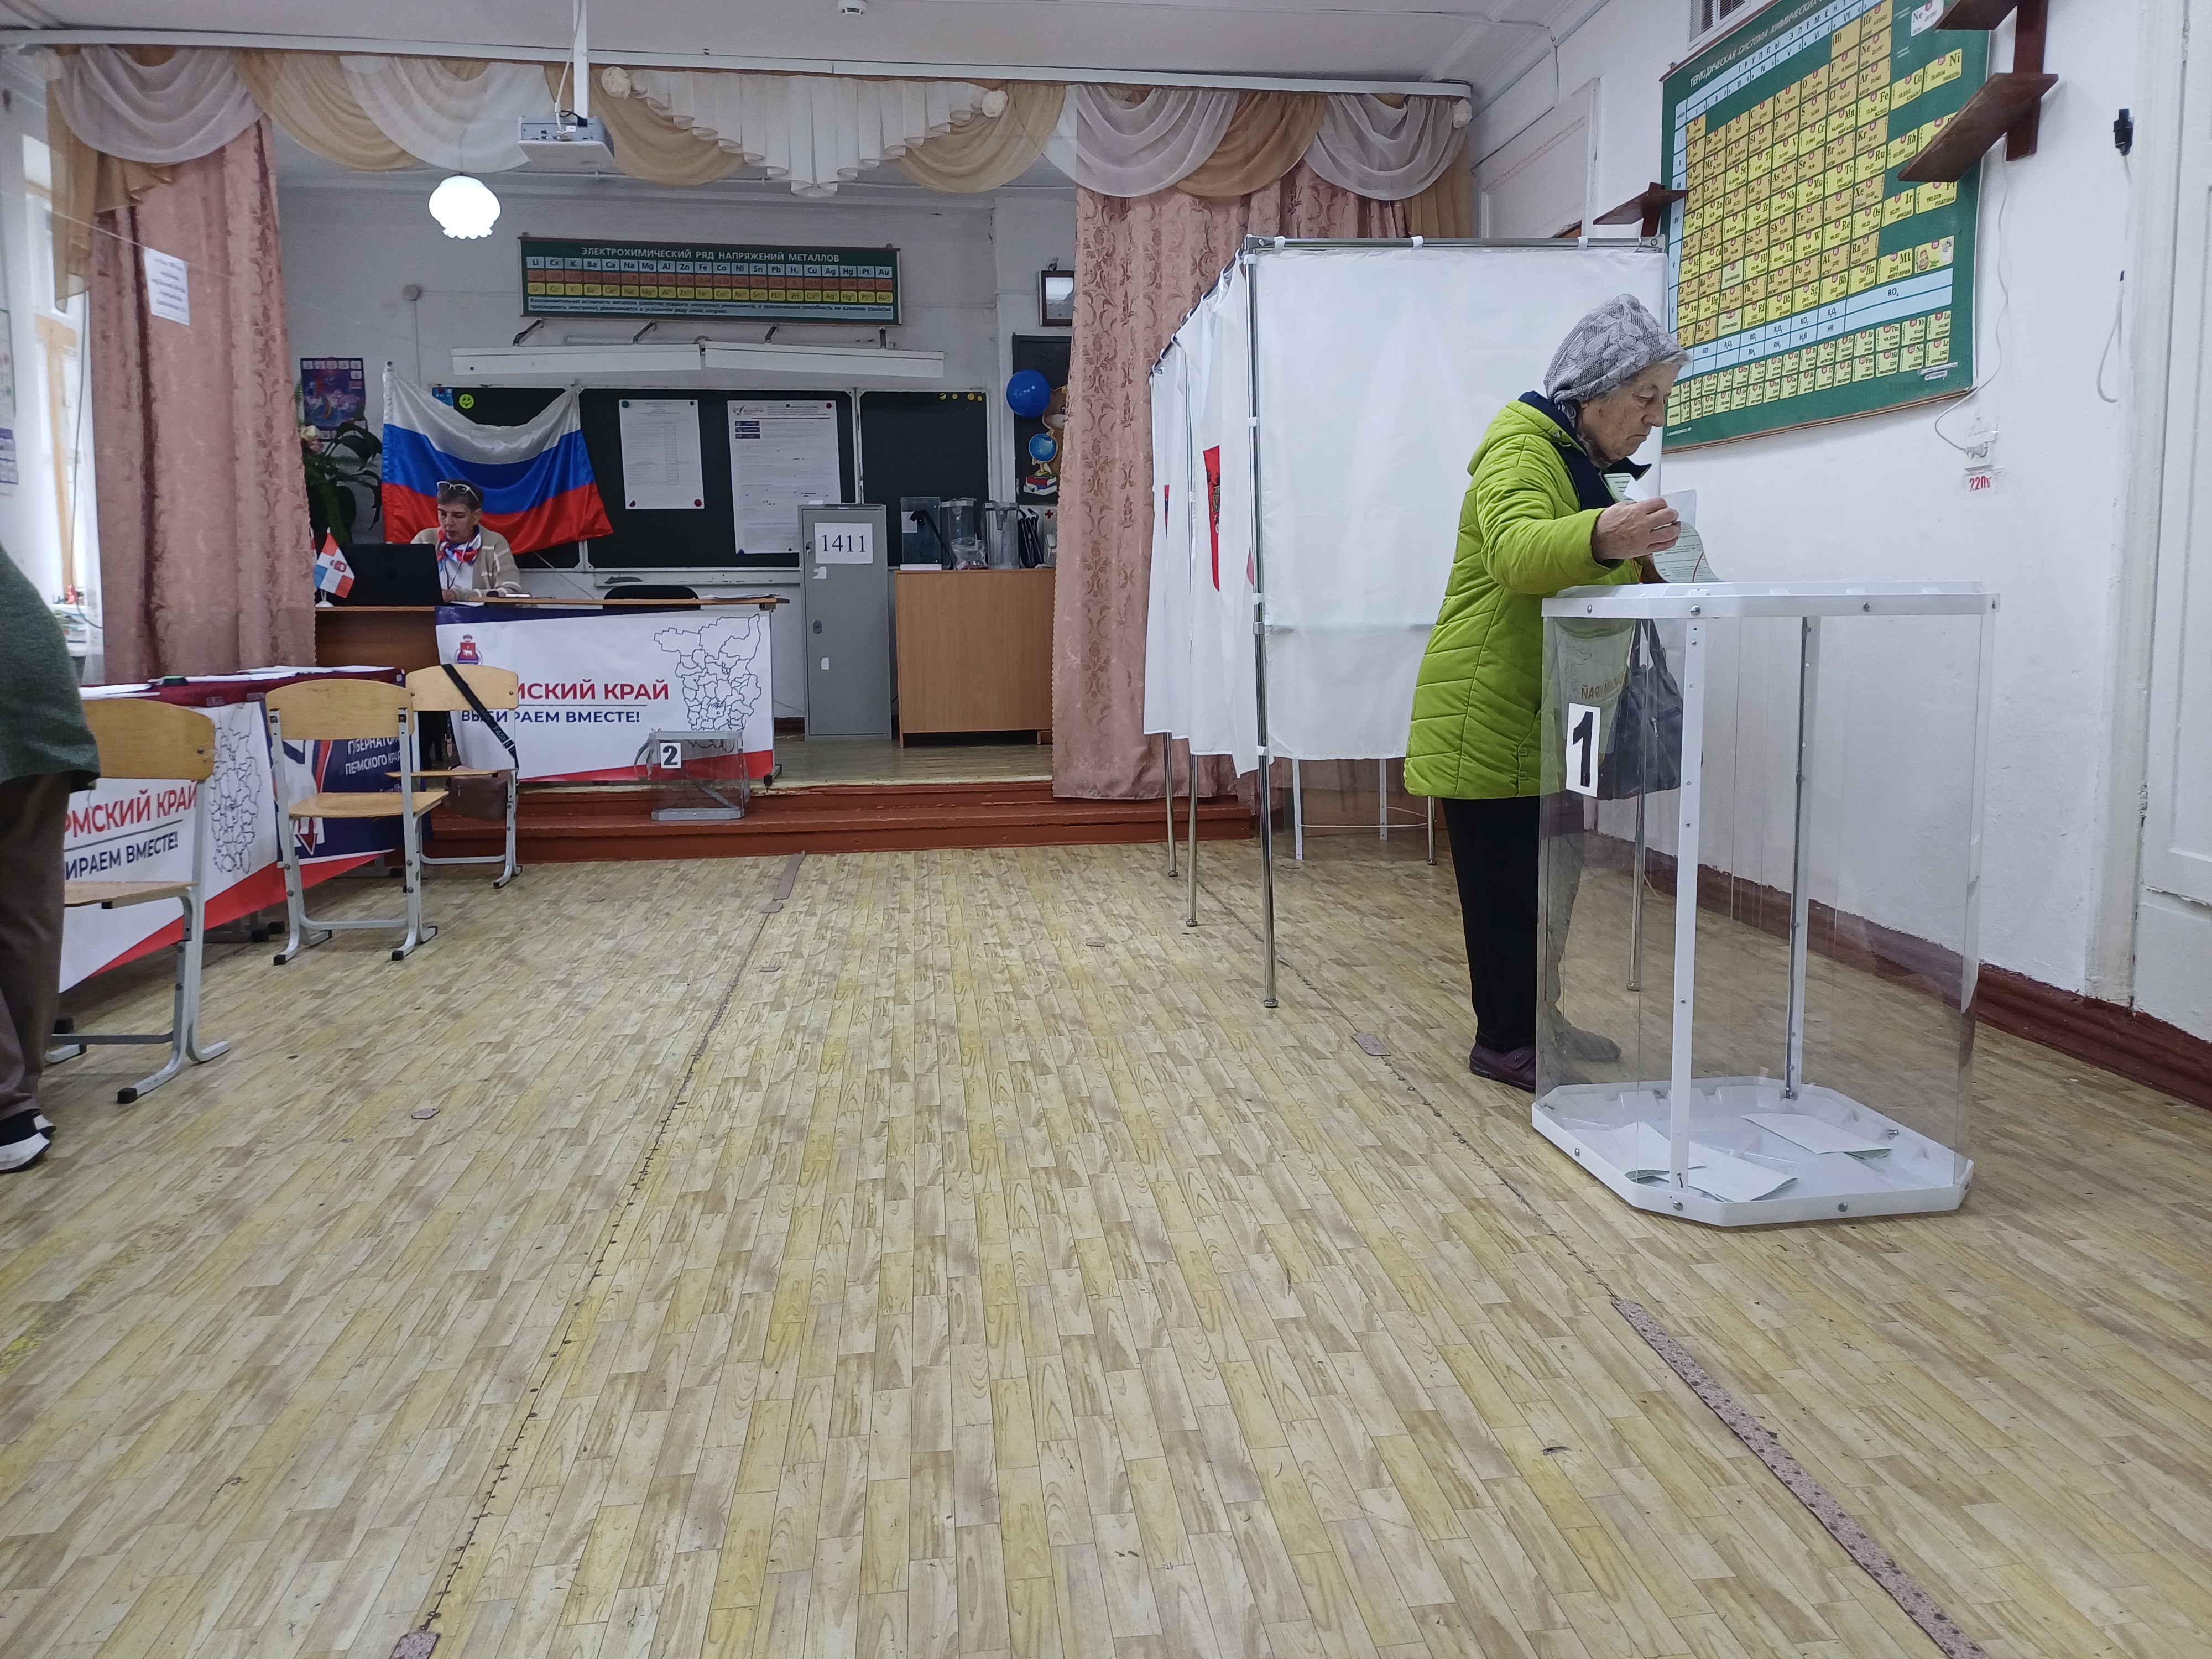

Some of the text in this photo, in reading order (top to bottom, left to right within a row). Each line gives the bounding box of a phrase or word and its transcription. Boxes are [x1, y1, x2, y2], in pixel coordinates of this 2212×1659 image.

[1913, 11, 1923, 23] Ne
[1690, 49, 1737, 87] ПЕРИОДИЧЕСКАЯ
[1738, 29, 1768, 54] СИСТЕМА
[1949, 52, 1960, 66] Ni
[1860, 74, 1868, 85] Ar
[1914, 74, 1922, 85] Co
[1880, 91, 1888, 103] Fe
[1845, 109, 1854, 120] Mn
[1858, 131, 1867, 142] Kr
[1907, 135, 1916, 145] Rh
[1875, 150, 1885, 161] Ru
[1799, 160, 1806, 170] Se
[1814, 178, 1822, 189] Mo
[1786, 190, 1794, 201] Nb
[1855, 187, 1864, 198] Xe
[1905, 193, 1912, 204] Ir
[1873, 207, 1880, 217] Os
[1842, 221, 1850, 231] Re
[1814, 231, 1821, 241] W
[1853, 243, 1860, 254] Rn
[581, 247, 840, 263] ЭЛЕКТРОХИМИЧЕСКИЙ РЯД НАПРЯЖЕНИЙ МЕТАЛЛОВ
[1900, 252, 1911, 264] Mt
[642, 262, 654, 270] Mg
[843, 268, 853, 276] Hg
[1796, 265, 1802, 274] Po
[1811, 285, 1818, 296] Sg
[1783, 295, 1791, 304] Db
[821, 534, 866, 552] 1411
[518, 679, 669, 700] СКИЙ КРАЙ
[461, 710, 560, 723] ВЫИРАЕМ
[566, 711, 640, 723] ВМЕСТЕ!
[1572, 711, 1593, 788] 1
[662, 745, 679, 766] 2
[65, 789, 151, 838] РМСКИЙ
[65, 831, 178, 880] ИРАЕМ ВМЕСТЕ!
